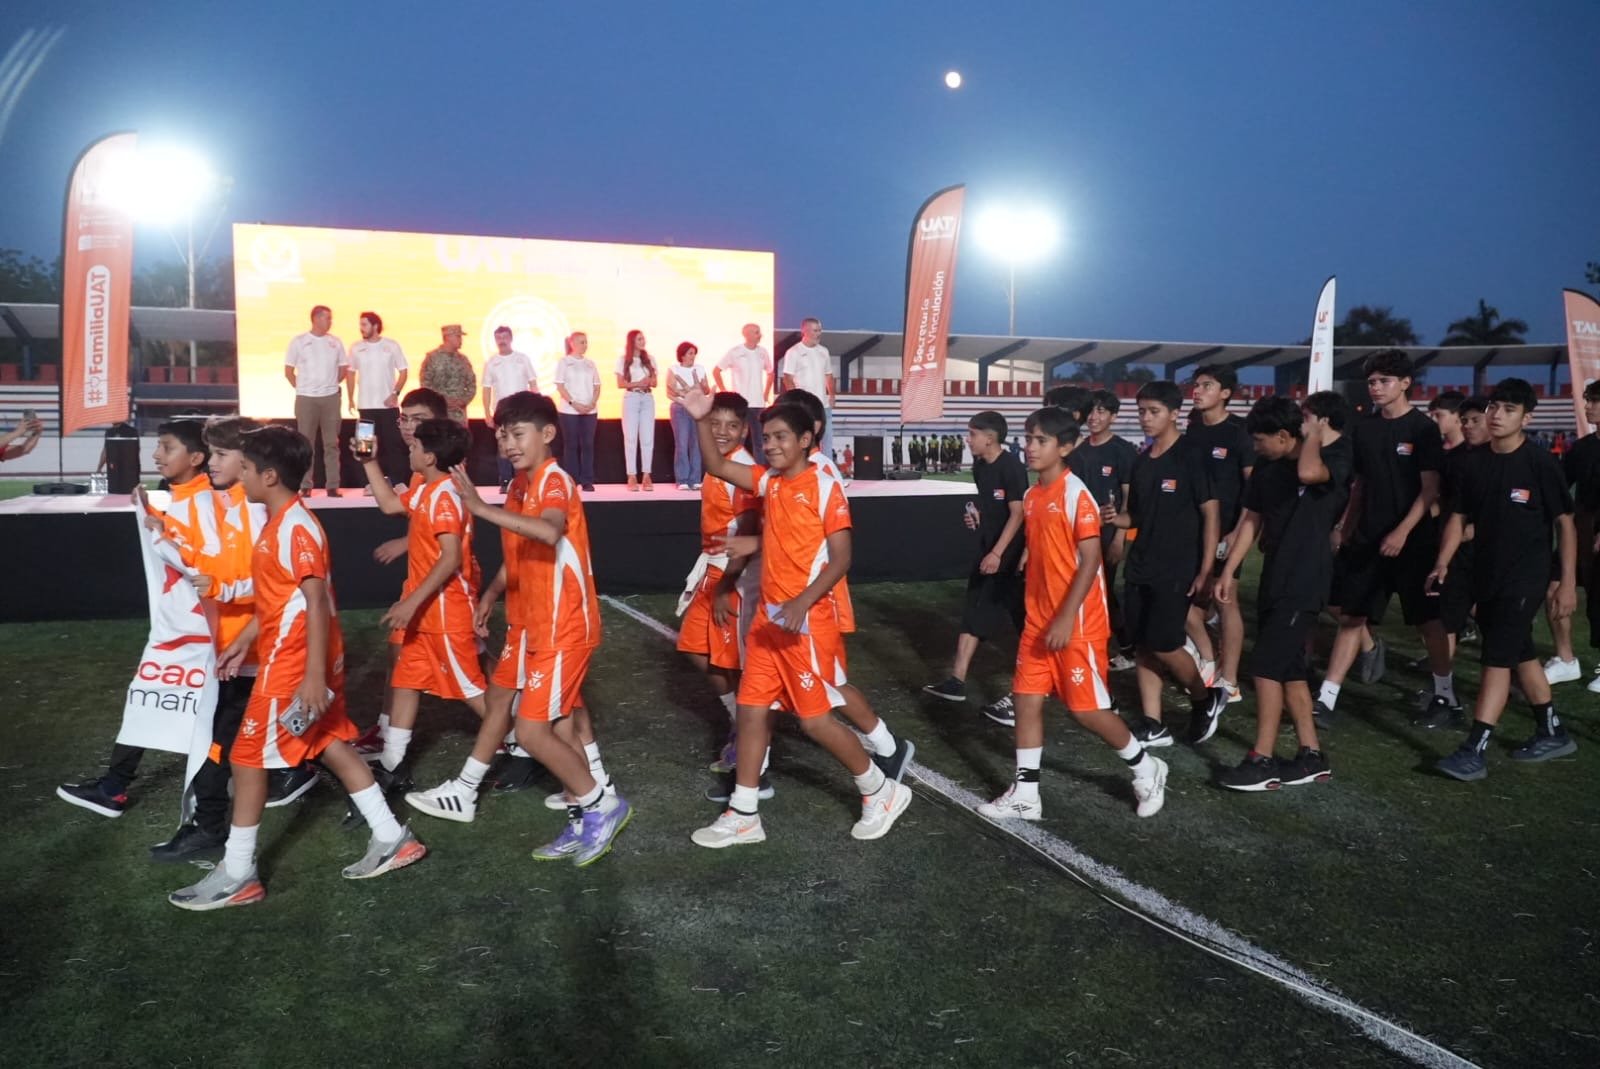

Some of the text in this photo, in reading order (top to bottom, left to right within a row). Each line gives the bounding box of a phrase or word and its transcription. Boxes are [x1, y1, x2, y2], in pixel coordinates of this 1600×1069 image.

[920, 215, 953, 232] UAT
[926, 271, 945, 362] de Vinculación
